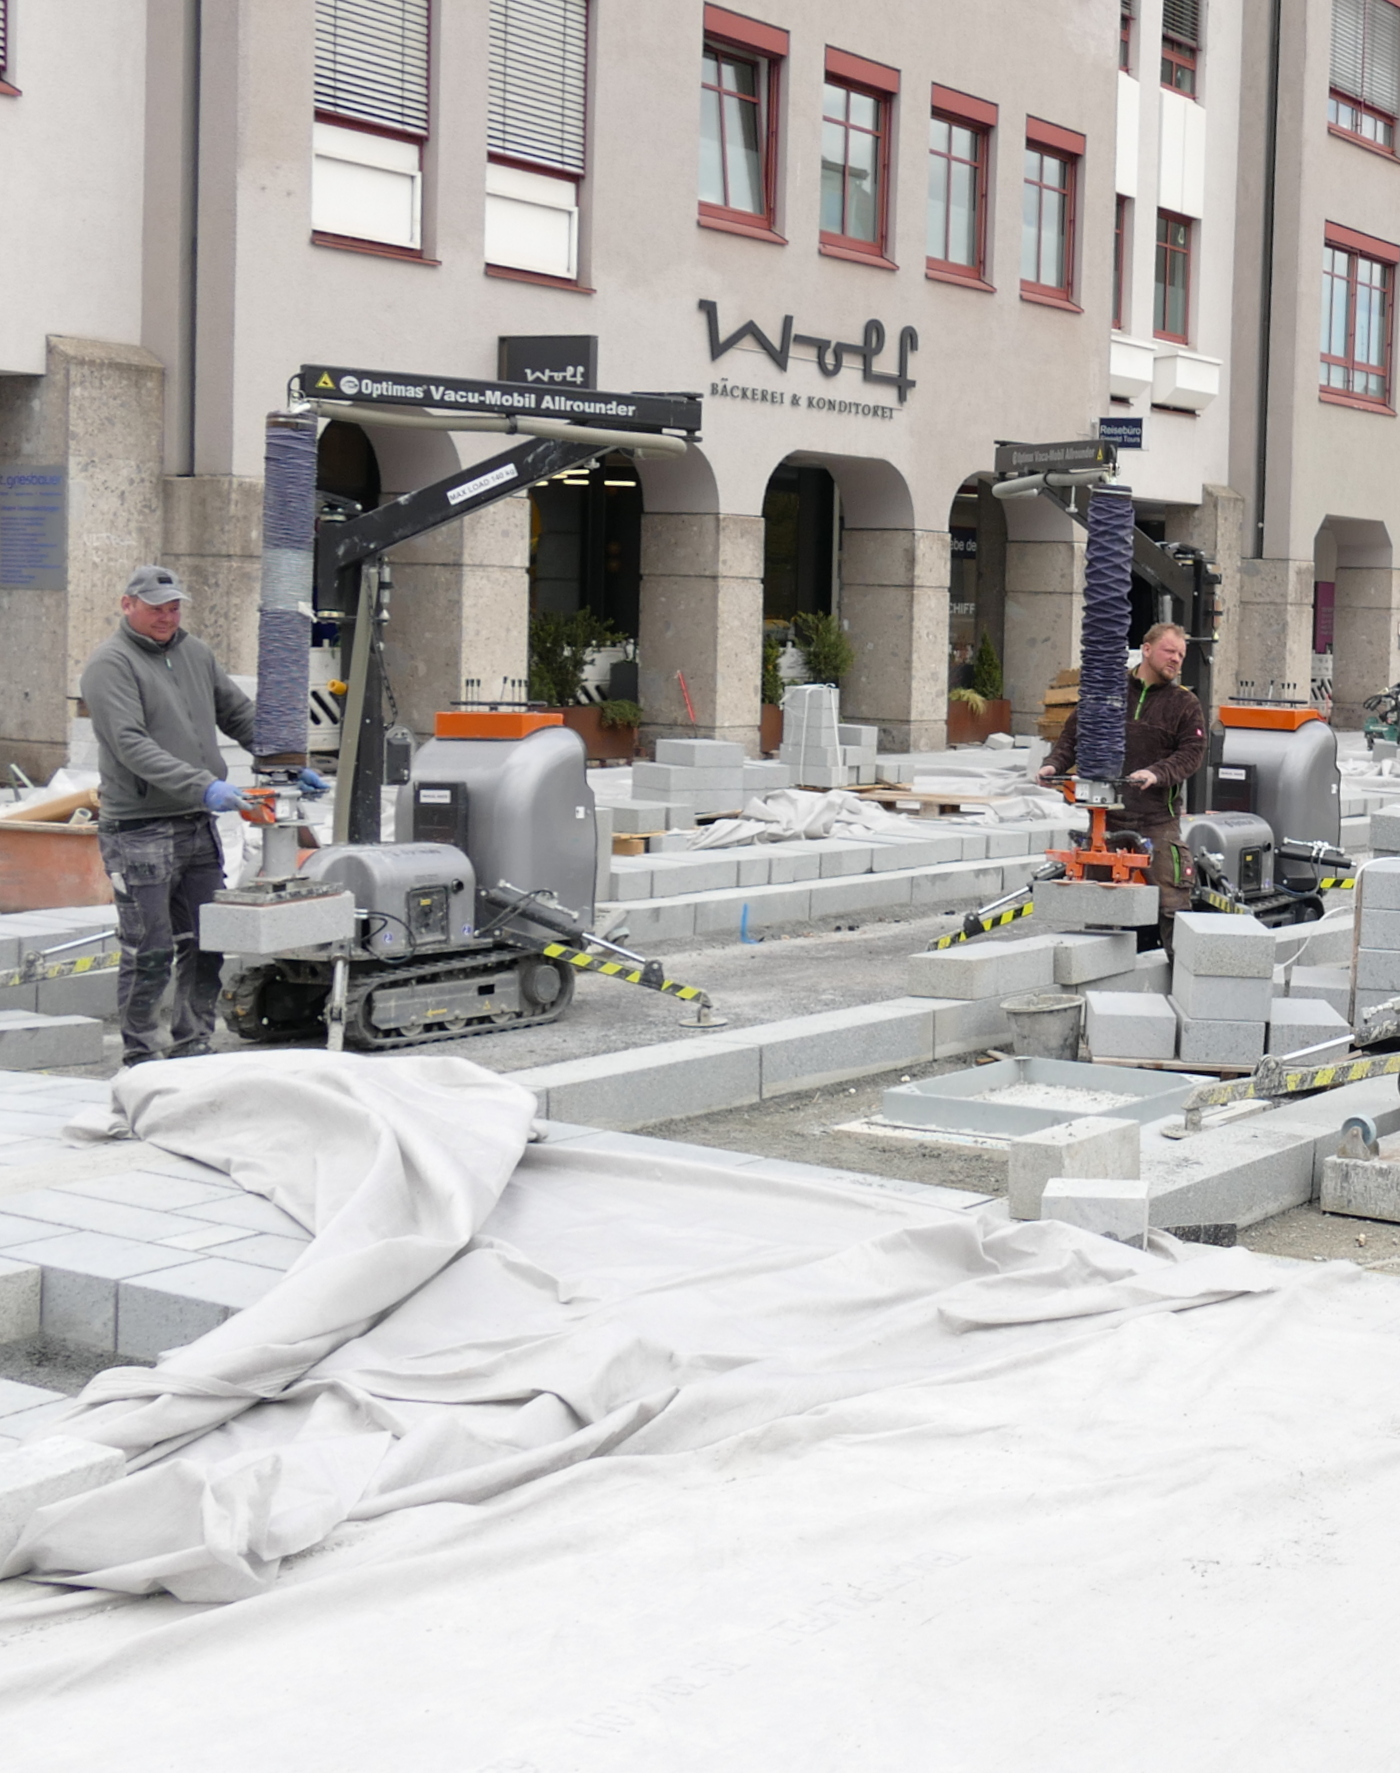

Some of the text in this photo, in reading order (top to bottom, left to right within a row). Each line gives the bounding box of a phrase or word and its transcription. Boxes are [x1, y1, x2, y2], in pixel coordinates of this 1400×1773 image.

[697, 298, 919, 404] Wolf
[361, 378, 637, 417] Optimas Vacu-Mobil Allrounder
[710, 377, 895, 420] BÄCKEREI & KONDITOREI
[1100, 425, 1142, 436] Reisebüro
[449, 489, 467, 501] MAX
[468, 478, 490, 493] LOAD
[491, 472, 505, 482] 140
